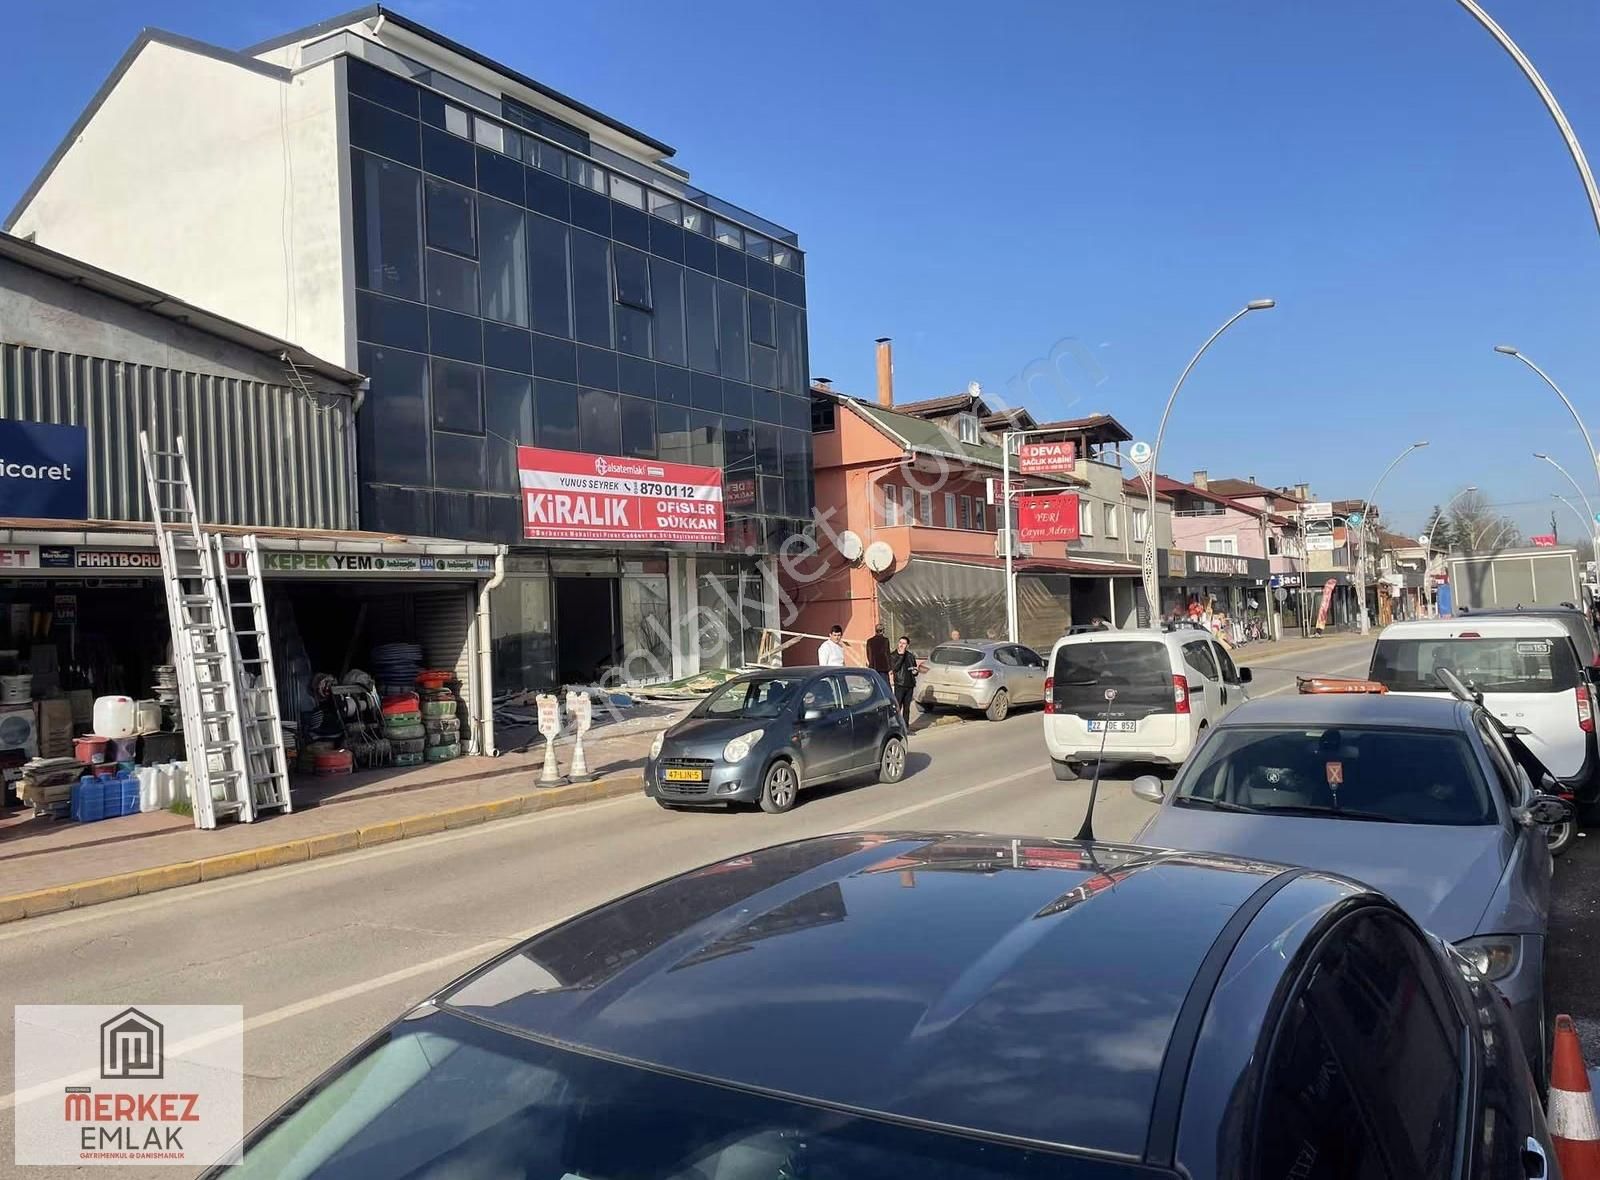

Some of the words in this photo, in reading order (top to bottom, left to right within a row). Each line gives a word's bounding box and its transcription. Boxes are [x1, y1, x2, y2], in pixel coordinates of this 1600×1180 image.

[1030, 446, 1061, 456] DEVA
[560, 478, 587, 488] YUNUS
[588, 480, 619, 490] SEYREK
[640, 483, 662, 495] 879
[665, 485, 677, 496] 01
[681, 486, 694, 498] 12
[656, 515, 717, 529] DÜKKAN
[0, 550, 31, 566] ET
[263, 553, 330, 569] KEPEK
[333, 555, 372, 570] YEM
[1092, 721, 1101, 729] 22
[1121, 721, 1134, 730] 852
